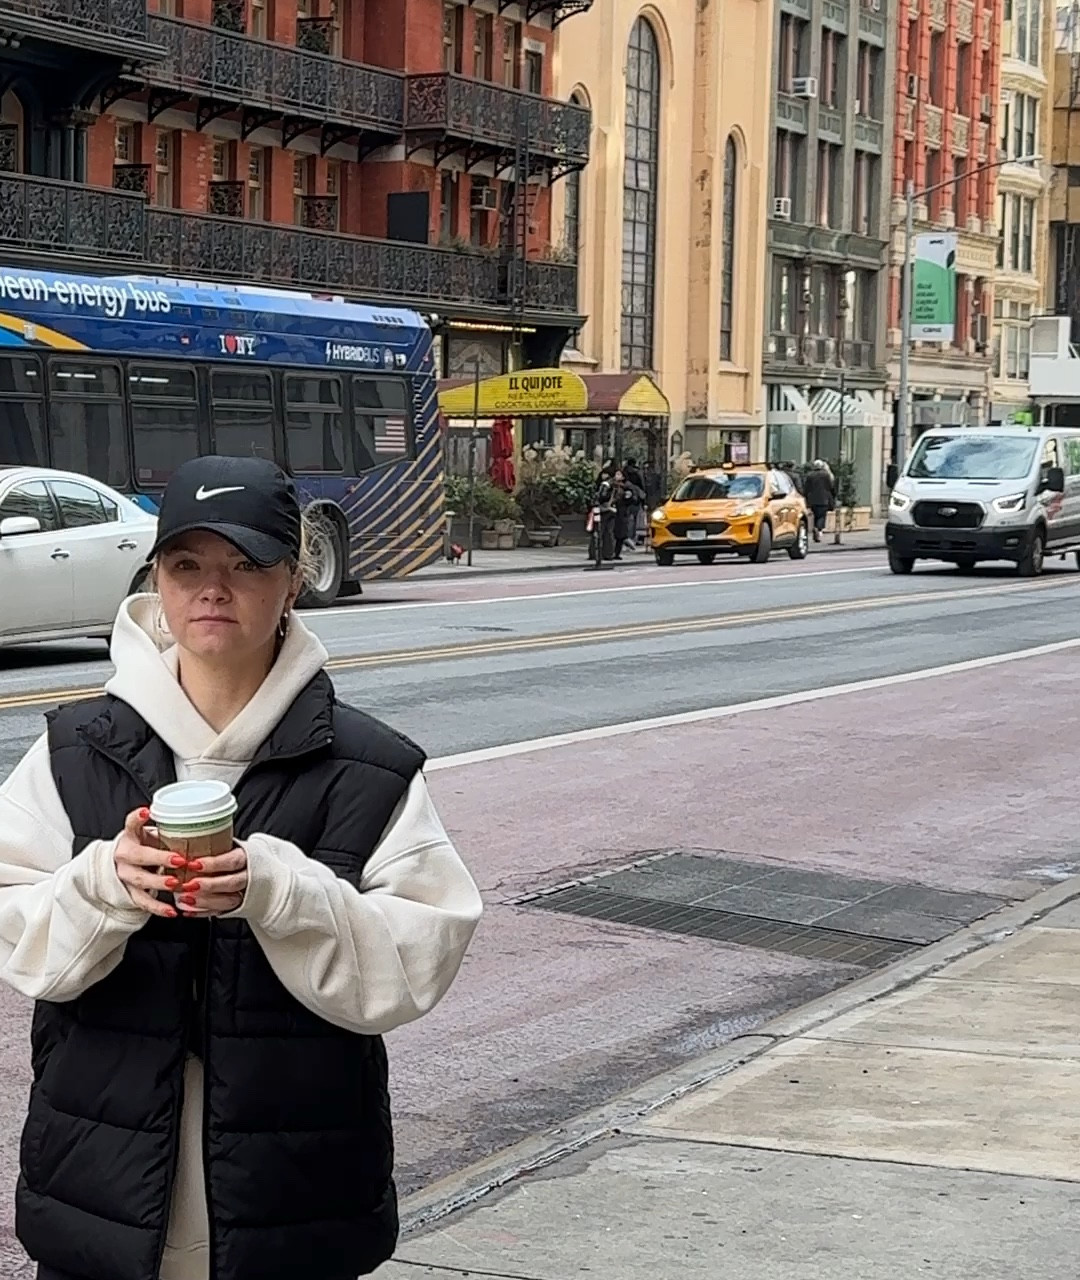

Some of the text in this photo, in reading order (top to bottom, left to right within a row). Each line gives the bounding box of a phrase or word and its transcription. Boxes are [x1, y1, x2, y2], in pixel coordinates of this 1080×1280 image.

[128, 283, 171, 313] bus
[236, 336, 256, 355] NY
[509, 376, 563, 391] EL QUIJOTE
